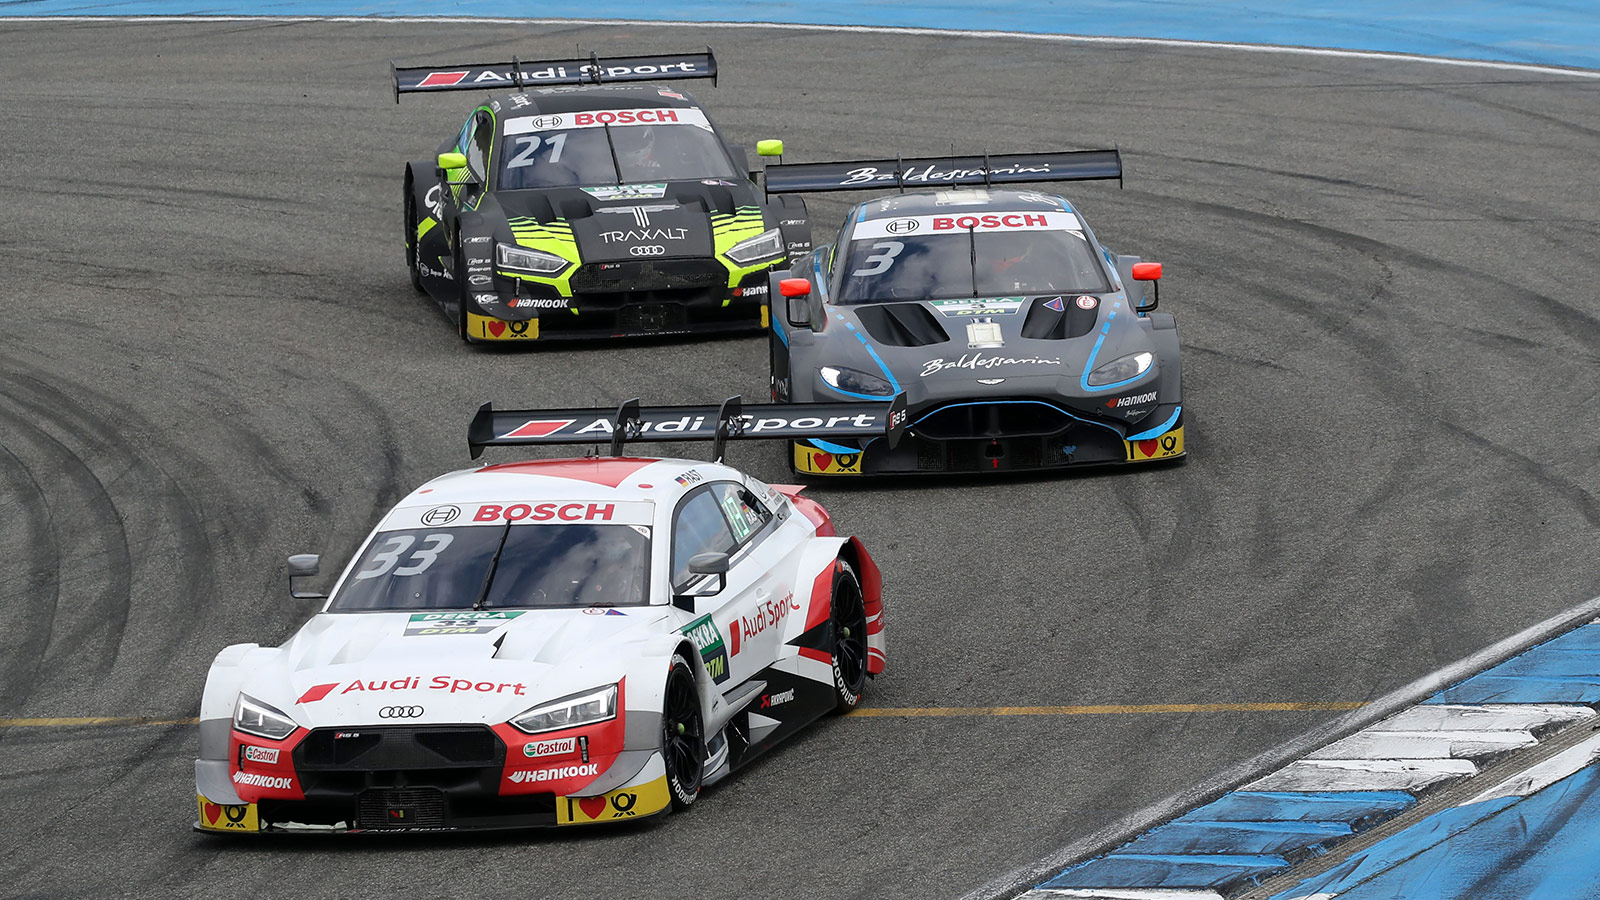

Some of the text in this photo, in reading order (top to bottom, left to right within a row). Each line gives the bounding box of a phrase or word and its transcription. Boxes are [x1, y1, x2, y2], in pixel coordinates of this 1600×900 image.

[575, 111, 678, 126] BOSCH
[507, 132, 568, 169] 21
[933, 214, 1048, 231] BOSCH
[599, 228, 688, 243] TRAXALT
[852, 241, 905, 277] 3
[742, 286, 768, 296] HANK
[943, 296, 1014, 305] DEKRA
[920, 352, 1060, 377] Baldessarini
[472, 503, 616, 522] BOSCH
[354, 533, 455, 580] 33
[423, 611, 508, 622] DEKRA
[432, 620, 479, 628] 33
[742, 590, 801, 643] Audi Sport
[417, 627, 479, 636] DTM
[341, 676, 527, 696] Audi Sport
[252, 748, 279, 762] Castrol
[536, 740, 573, 755] Castrol
